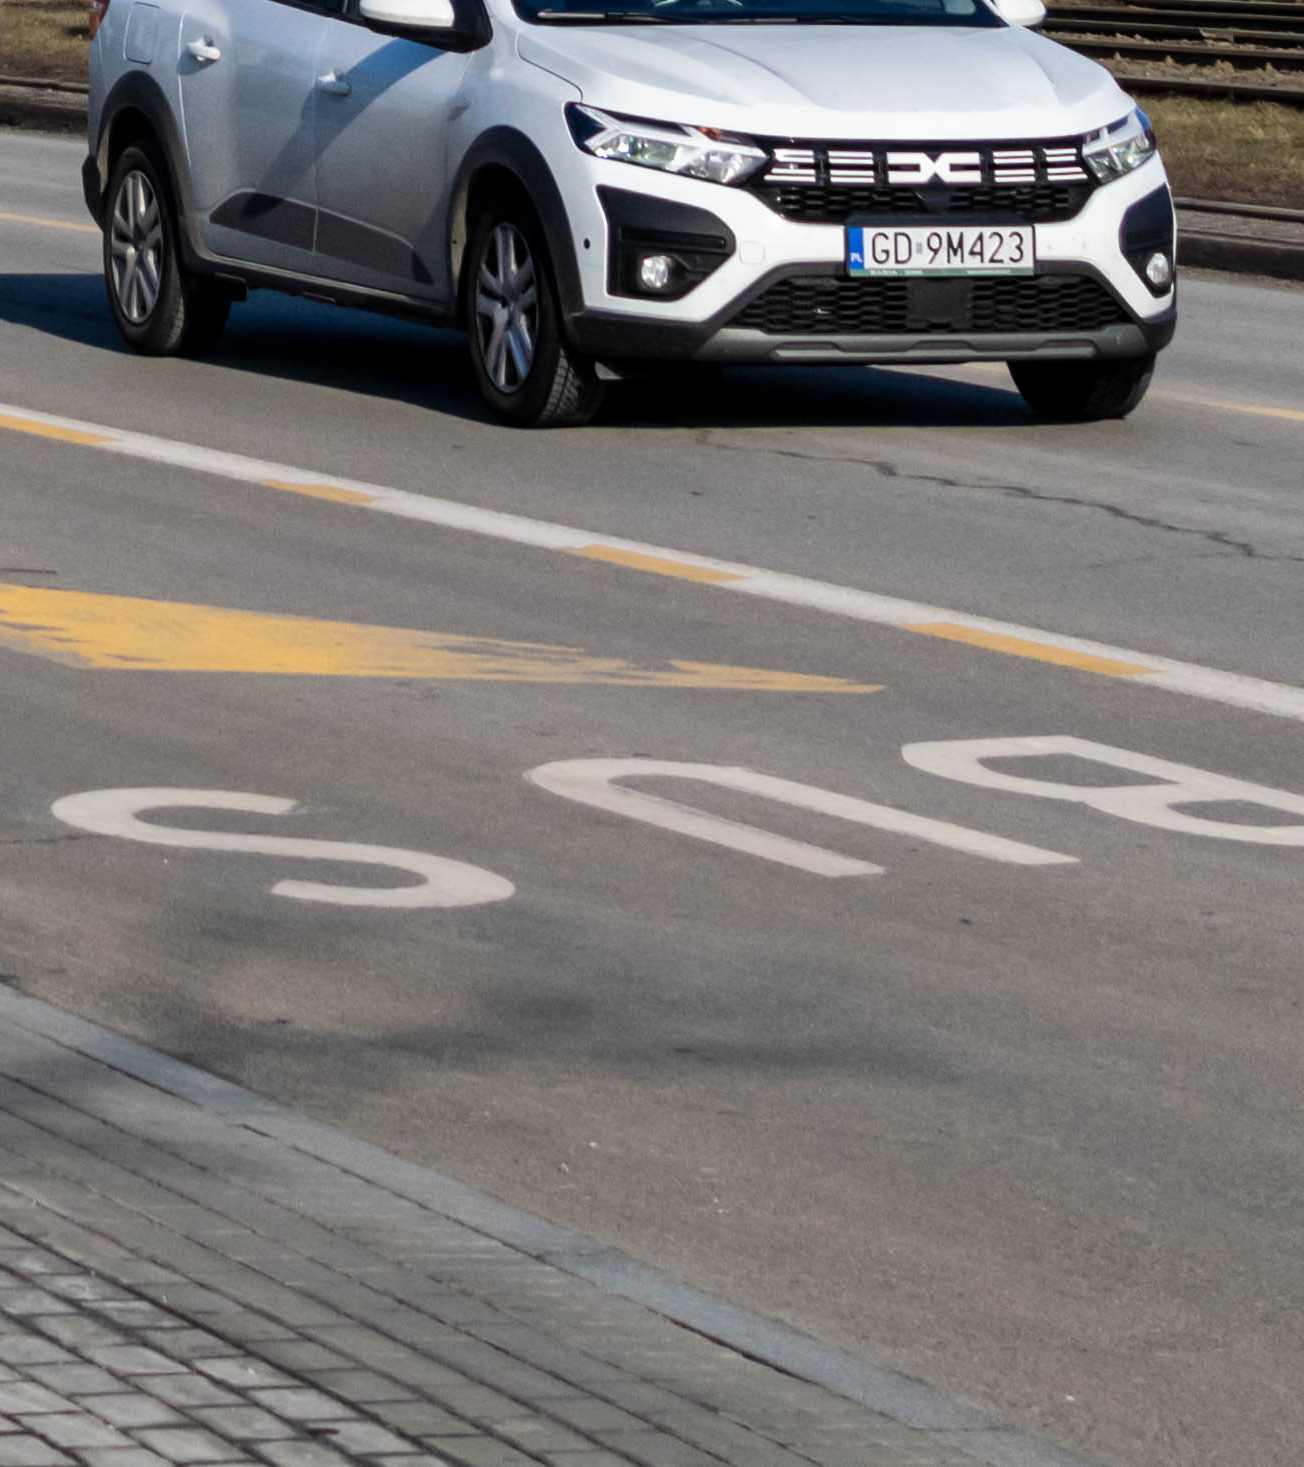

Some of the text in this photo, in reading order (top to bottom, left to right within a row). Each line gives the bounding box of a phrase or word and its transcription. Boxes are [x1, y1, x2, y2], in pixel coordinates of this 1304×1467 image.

[871, 231, 912, 265] GD
[926, 230, 1024, 265] 9M423
[50, 734, 1304, 909] BUS
